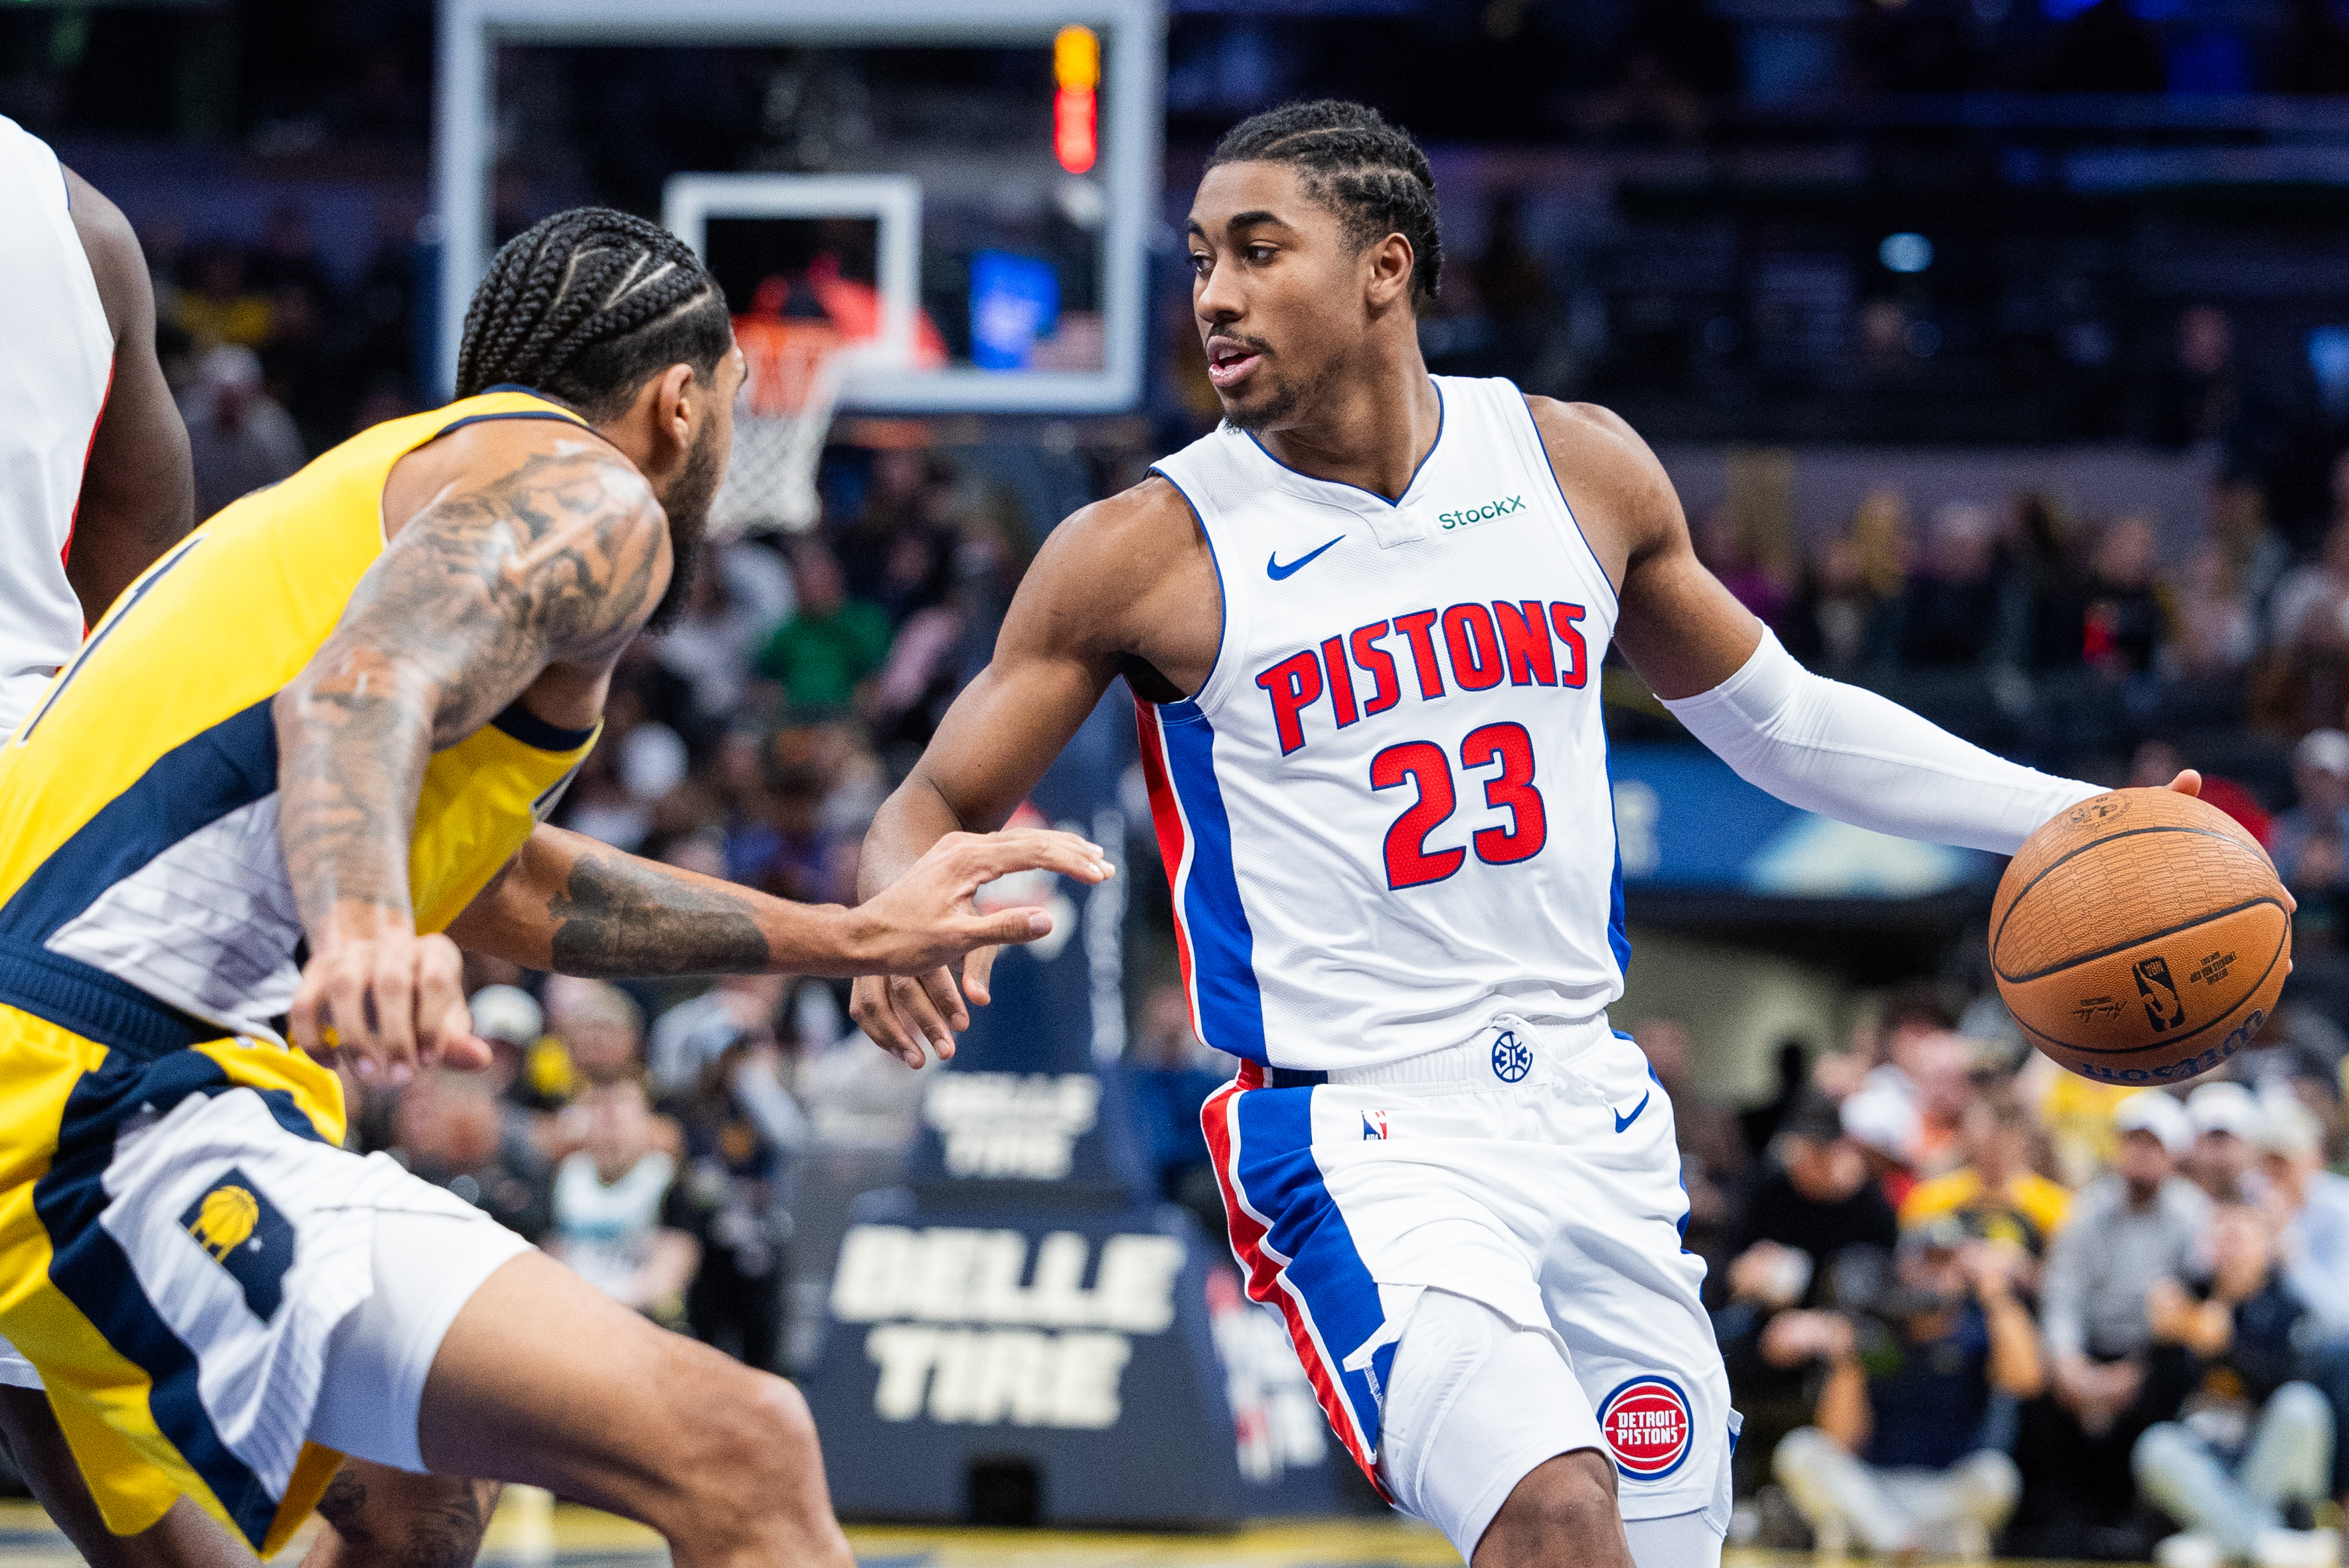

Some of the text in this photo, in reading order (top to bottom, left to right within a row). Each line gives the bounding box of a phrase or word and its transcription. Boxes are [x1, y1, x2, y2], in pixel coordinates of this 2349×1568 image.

[1439, 495, 1526, 529] StockX
[1256, 600, 1587, 757] PISTONS
[1370, 721, 1547, 890] 23
[2145, 961, 2164, 977] NBA
[832, 1225, 1185, 1332] BELLE
[867, 1325, 1130, 1429] TIRE
[1616, 1427, 1678, 1445] PISTONS
[1617, 1409, 1677, 1428] DETROIT
